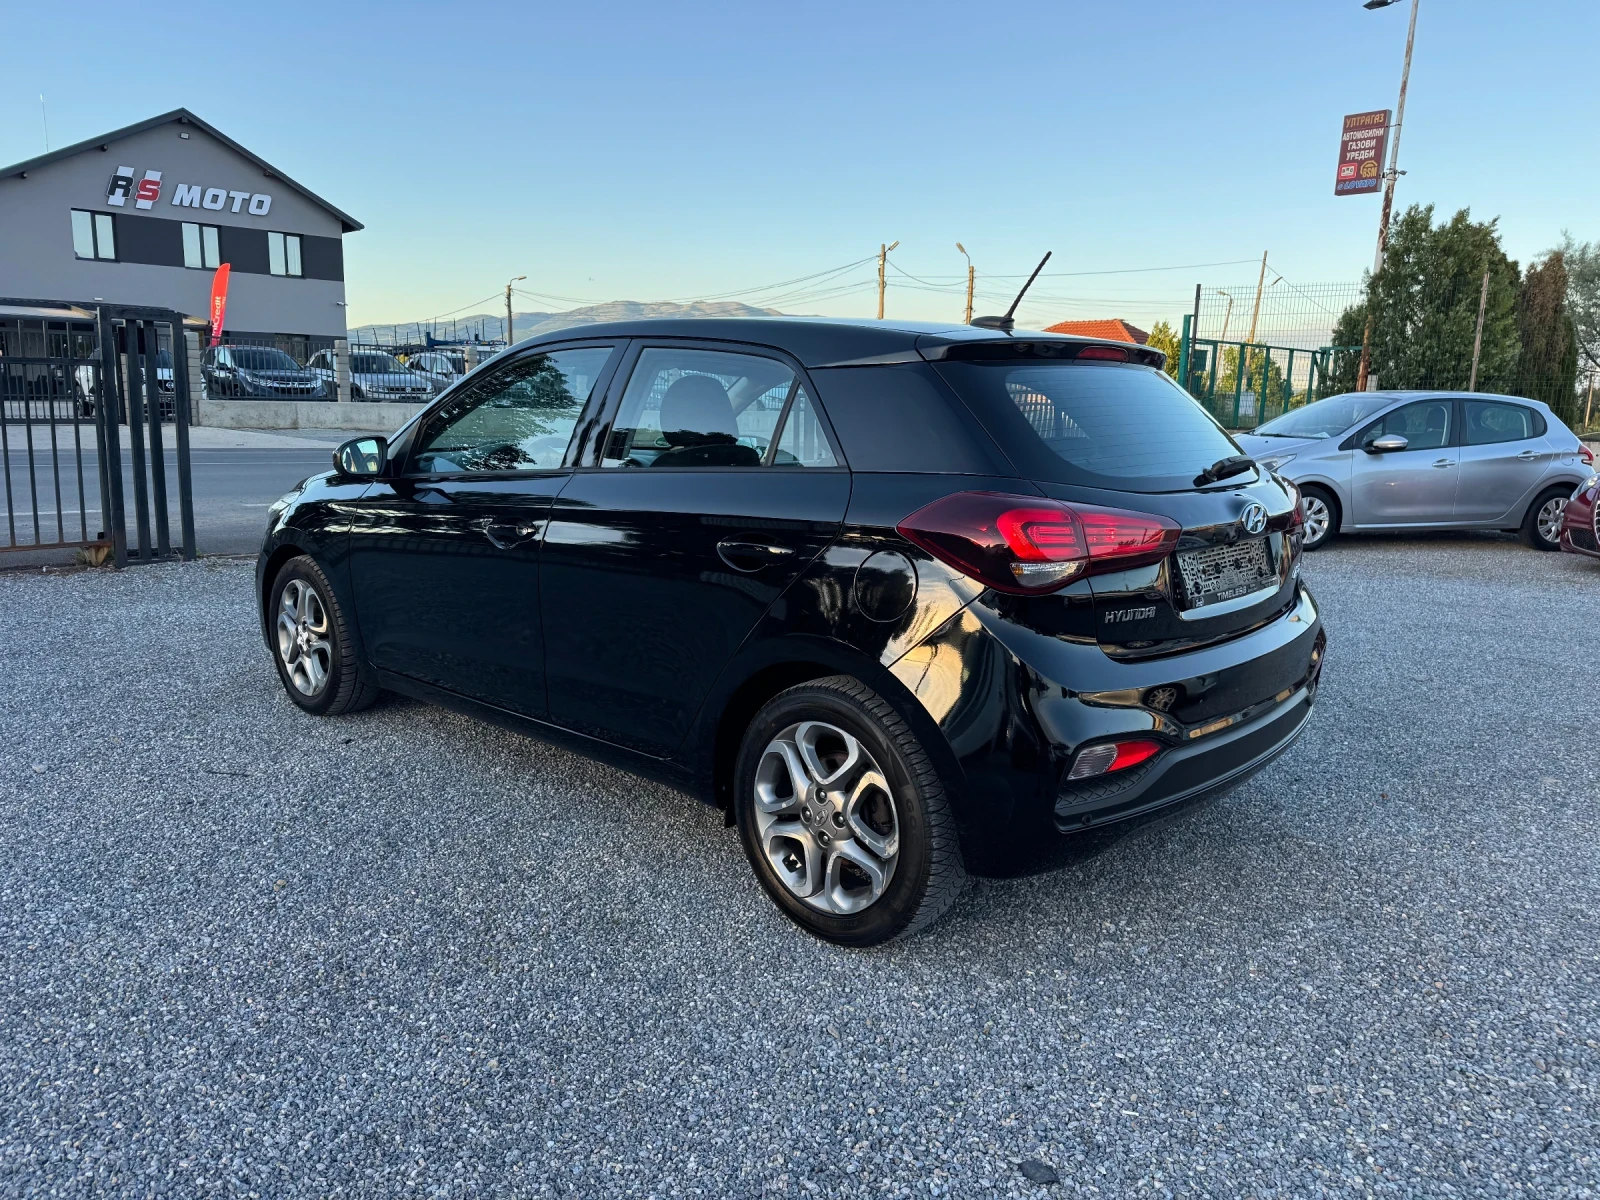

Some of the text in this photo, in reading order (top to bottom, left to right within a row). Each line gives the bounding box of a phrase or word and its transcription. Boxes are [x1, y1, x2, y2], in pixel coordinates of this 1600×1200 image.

[1342, 128, 1384, 141] АВТОМОБИЛНИ
[1347, 139, 1376, 150] ГАЗОВИ
[1346, 149, 1375, 161] УРЕДБИ
[1362, 167, 1378, 178] GSM
[172, 183, 272, 216] MOTO
[1217, 586, 1247, 601] TIMELESS
[1104, 606, 1156, 624] HYUNDAI
